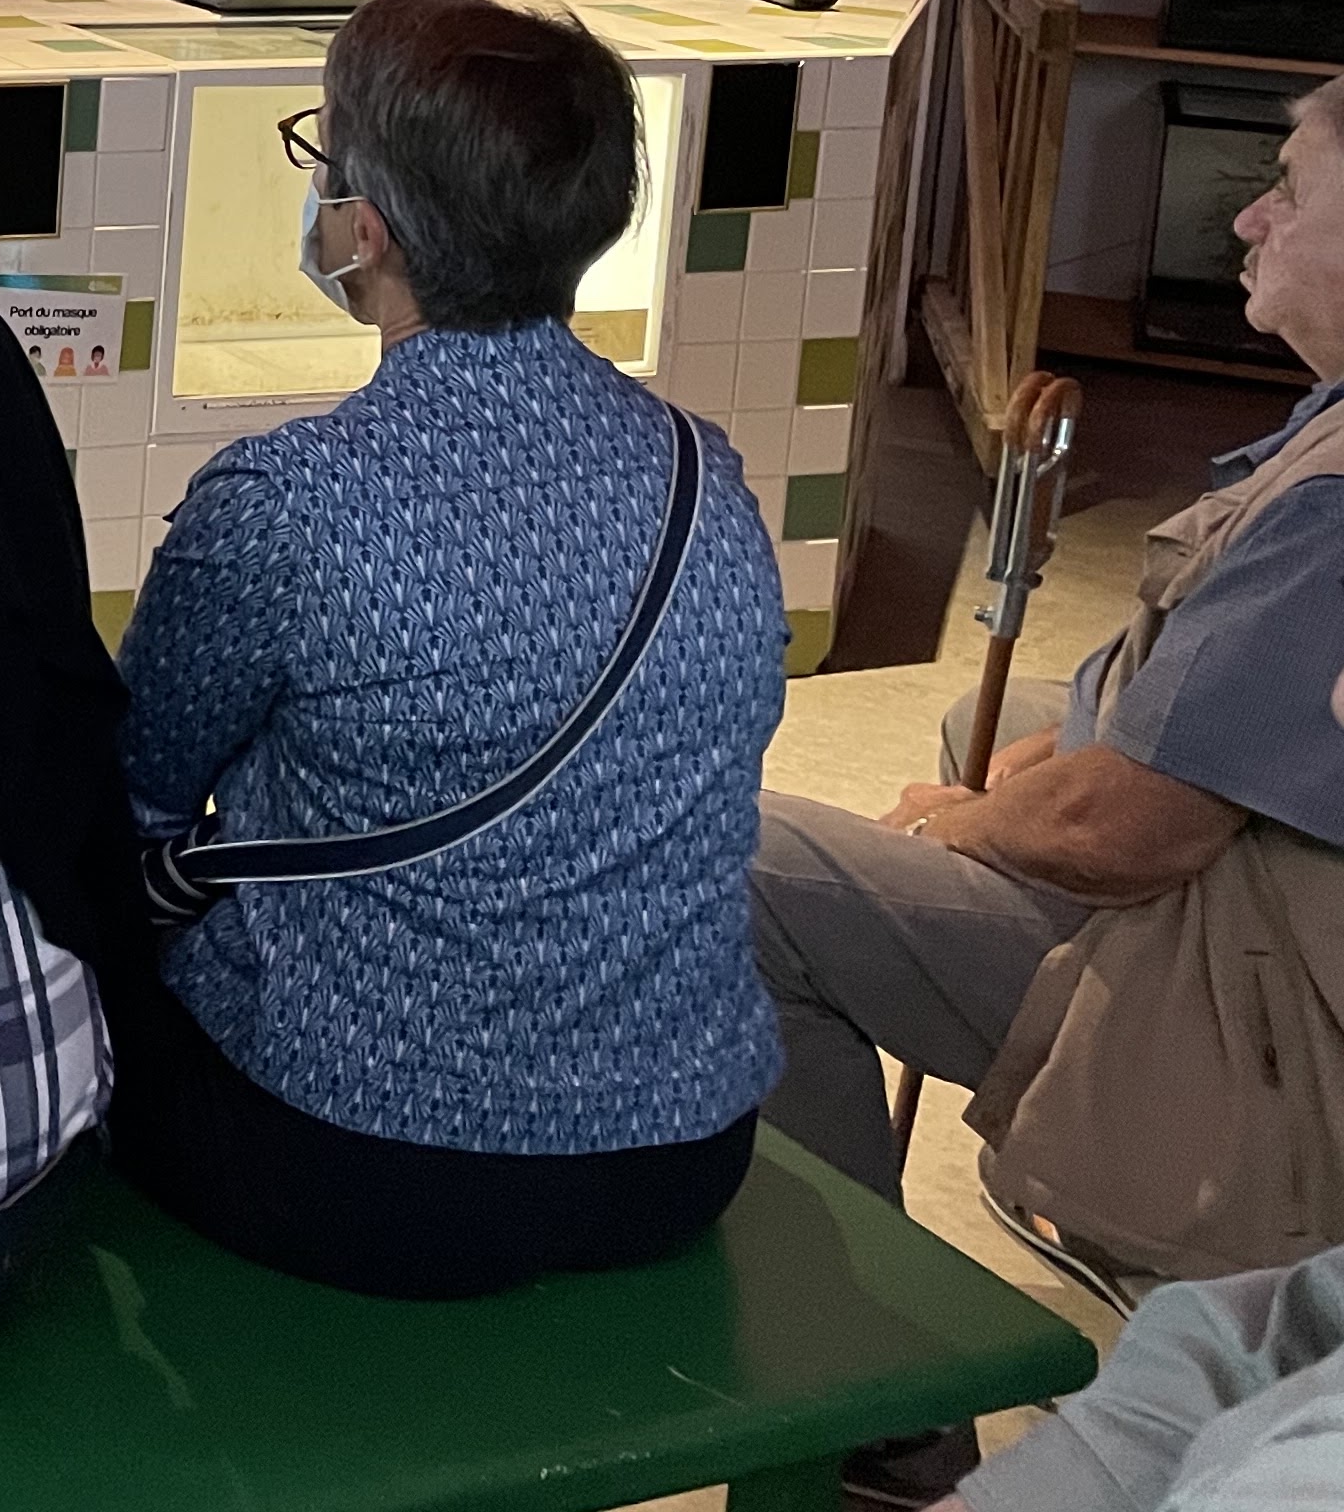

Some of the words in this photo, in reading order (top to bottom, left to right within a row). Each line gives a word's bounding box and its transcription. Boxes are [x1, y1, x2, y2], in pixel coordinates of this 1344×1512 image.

[9, 306, 33, 318] Port
[35, 306, 51, 318] du
[52, 308, 98, 320] masque
[24, 325, 81, 339] obligatoire
